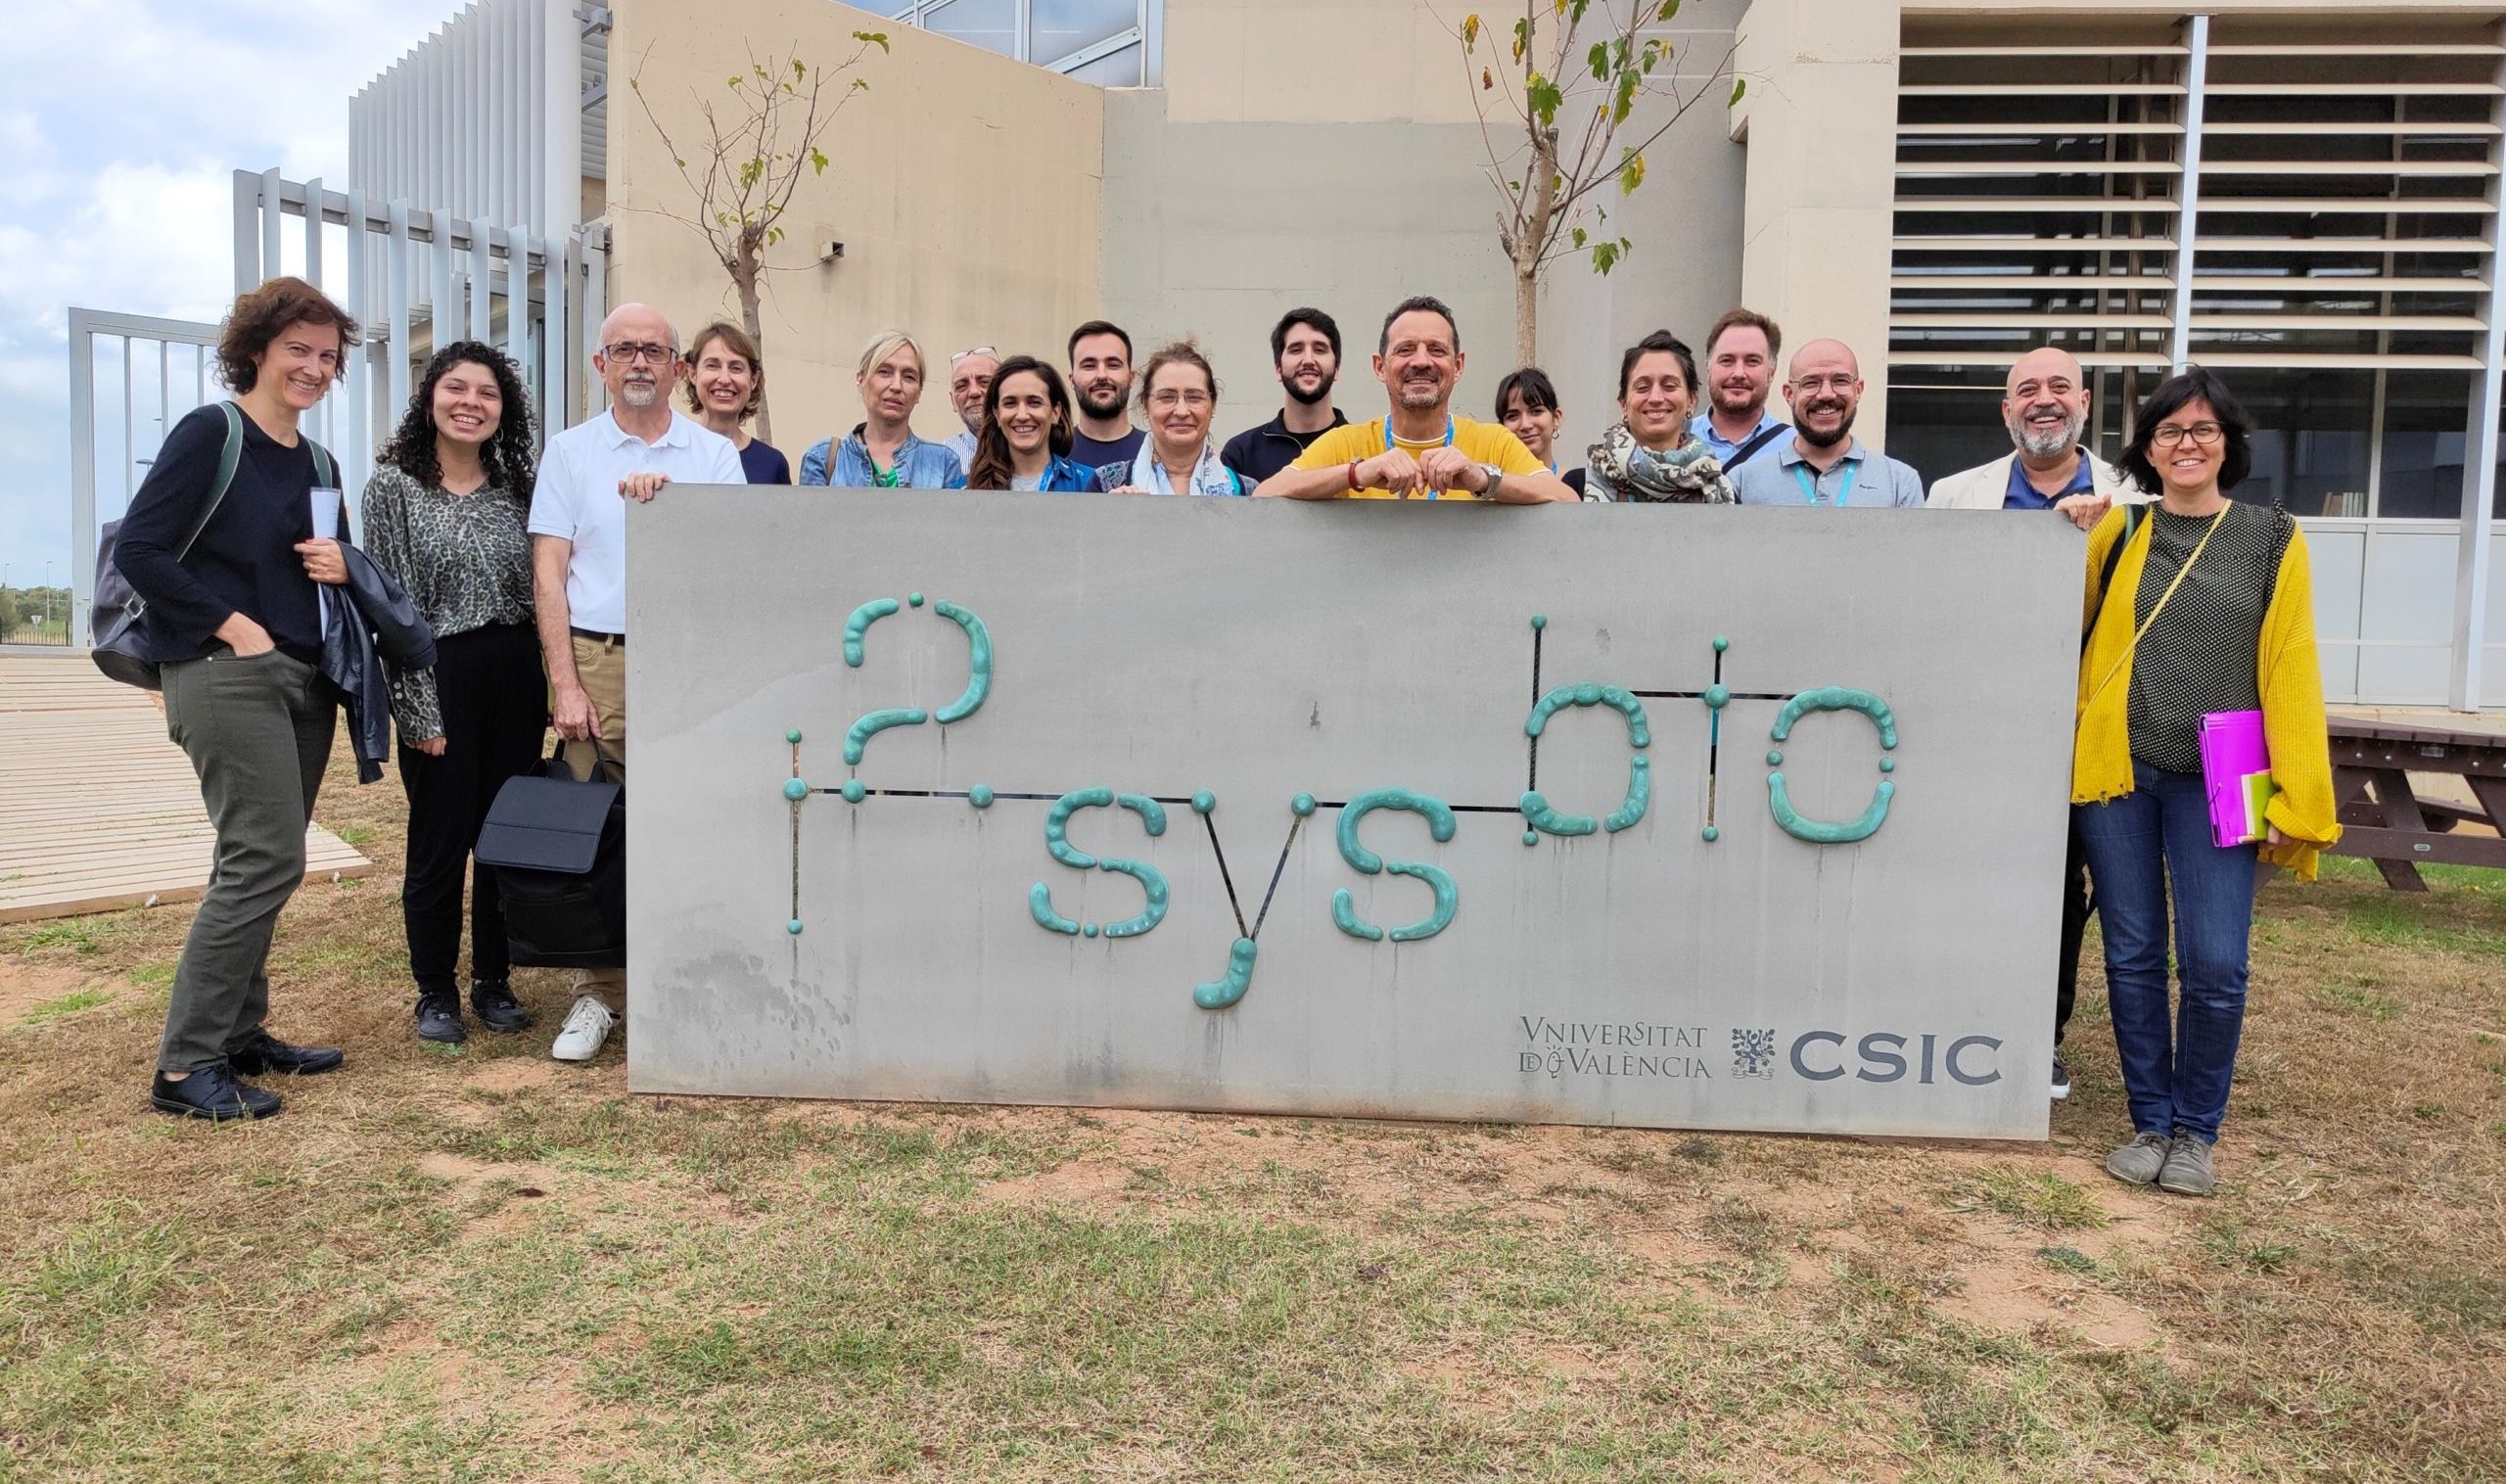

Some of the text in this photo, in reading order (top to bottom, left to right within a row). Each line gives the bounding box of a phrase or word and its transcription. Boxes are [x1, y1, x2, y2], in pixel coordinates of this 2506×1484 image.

[1519, 1015, 1709, 1048] VNIVERSITAT
[1566, 1046, 1714, 1079] VALÈNCIA
[1789, 1030, 2004, 1087] CSIC
